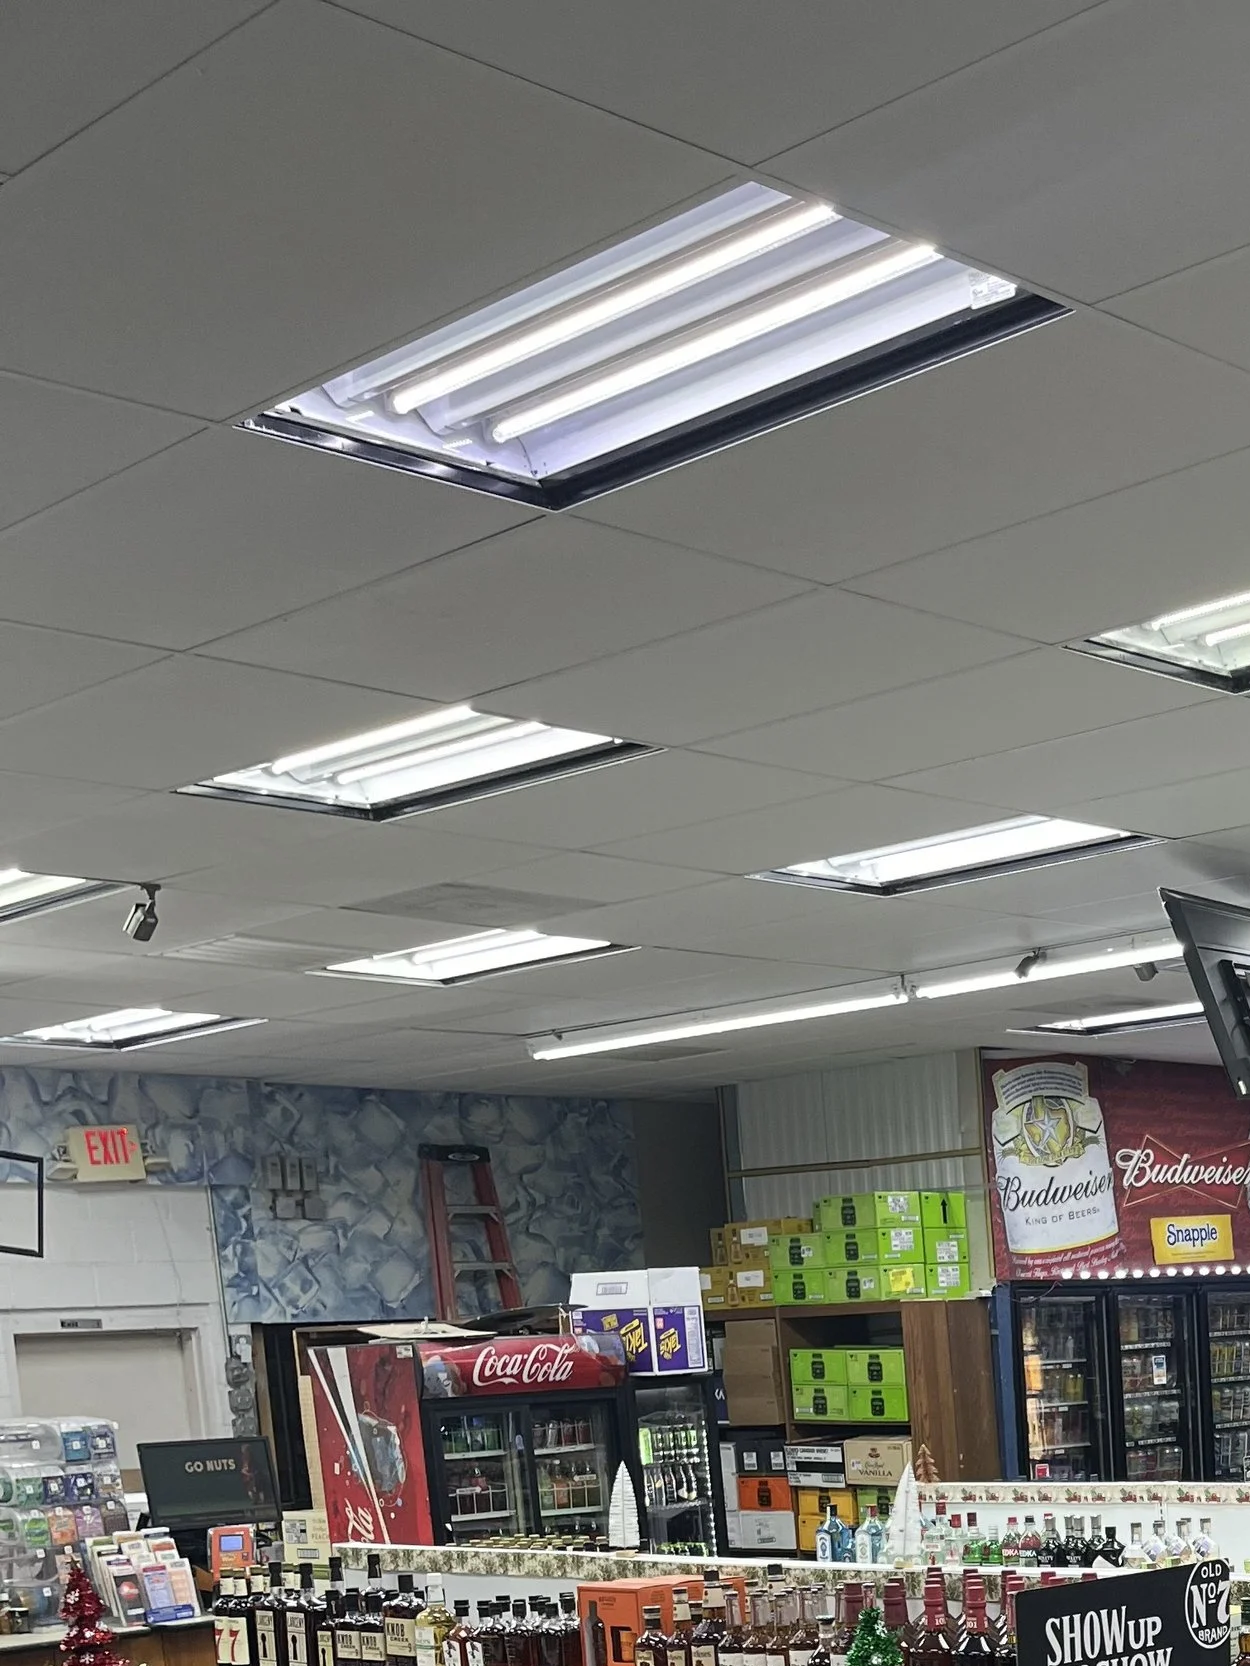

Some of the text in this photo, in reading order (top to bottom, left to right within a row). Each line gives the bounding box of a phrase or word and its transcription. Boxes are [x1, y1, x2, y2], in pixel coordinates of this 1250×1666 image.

[85, 1129, 129, 1165] EXIT
[998, 1170, 1113, 1212] Budweiser
[1025, 1208, 1097, 1226] KING OF BEERS
[1166, 1222, 1218, 1246] Snapple
[472, 1343, 578, 1386] Coca-Cola
[185, 1458, 236, 1473] GO NUTS
[858, 1468, 893, 1477] VANILLA
[1201, 1563, 1222, 1579] OLD
[1127, 1616, 1162, 1650] UP
[1198, 1625, 1230, 1643] BRAND
